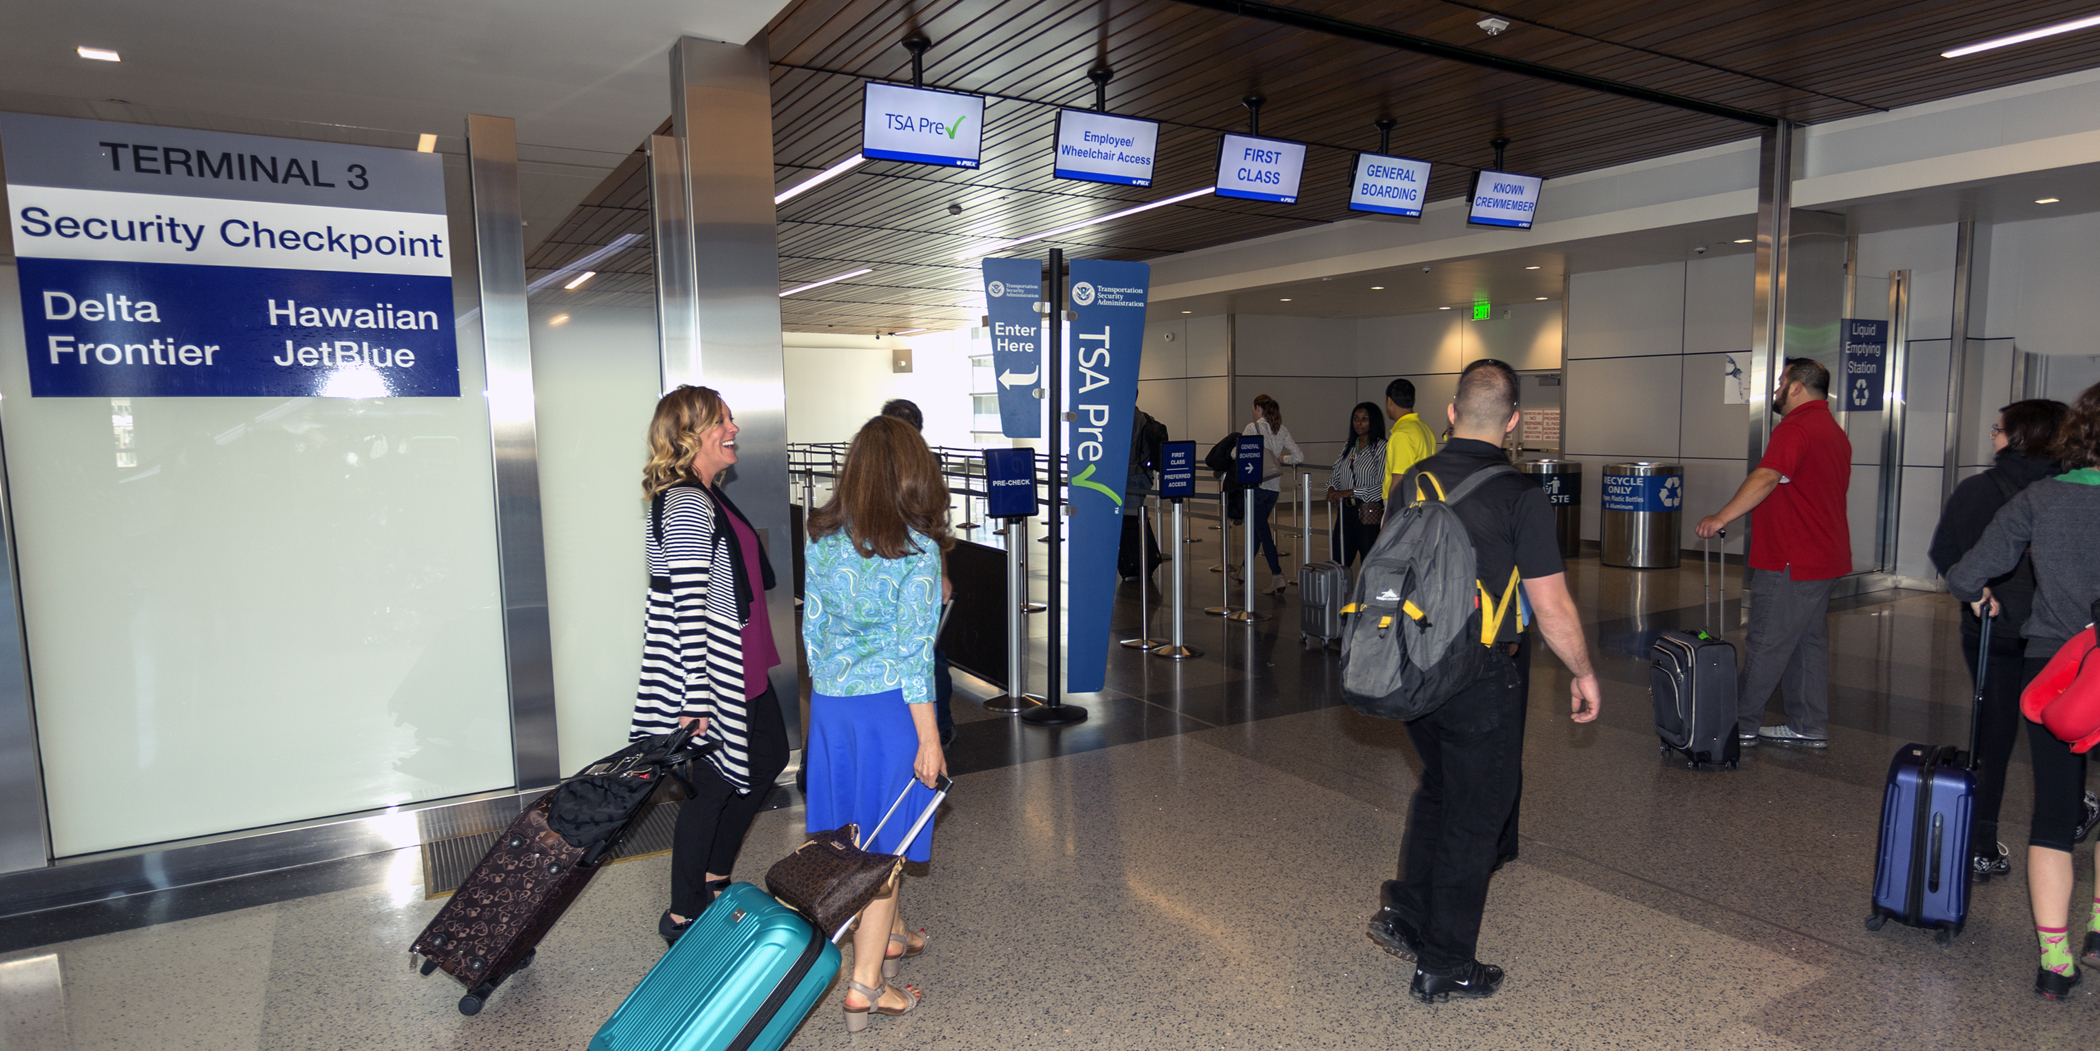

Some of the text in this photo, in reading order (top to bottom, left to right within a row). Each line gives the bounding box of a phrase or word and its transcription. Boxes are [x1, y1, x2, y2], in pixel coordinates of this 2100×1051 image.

[885, 113, 944, 135] TSA Pre
[1084, 131, 1135, 148] Employee/
[1061, 144, 1151, 165] Wheelchair Access
[1244, 148, 1282, 165] FIRST
[99, 141, 370, 191] TERMINAL 3
[1367, 164, 1416, 183] GENERAL
[1238, 168, 1281, 185] CLASS
[1361, 183, 1418, 201] BOARDING
[1493, 182, 1525, 196] KNOWN
[1475, 196, 1535, 212] CREWMEMBER
[20, 206, 444, 260] Security Checkpoint
[1097, 284, 1143, 294] Transportation
[1097, 292, 1124, 301] Security
[42, 291, 161, 323] Delta
[1097, 299, 1144, 307] Administration
[268, 298, 439, 330] Hawaiian
[995, 321, 1037, 336] Enter
[1852, 323, 1876, 338] Liquid
[48, 335, 220, 366] Frontier
[997, 338, 1034, 353] Here
[1845, 341, 1881, 357] Emptying
[273, 340, 416, 368] JetBlue
[1847, 361, 1876, 374] Station
[1077, 326, 1111, 461] TSA Pre
[992, 479, 1031, 487] PRE-CHECK
[1603, 476, 1644, 486] RECYCLE
[1608, 485, 1633, 494] ONLY
[1550, 494, 1570, 503] STE
